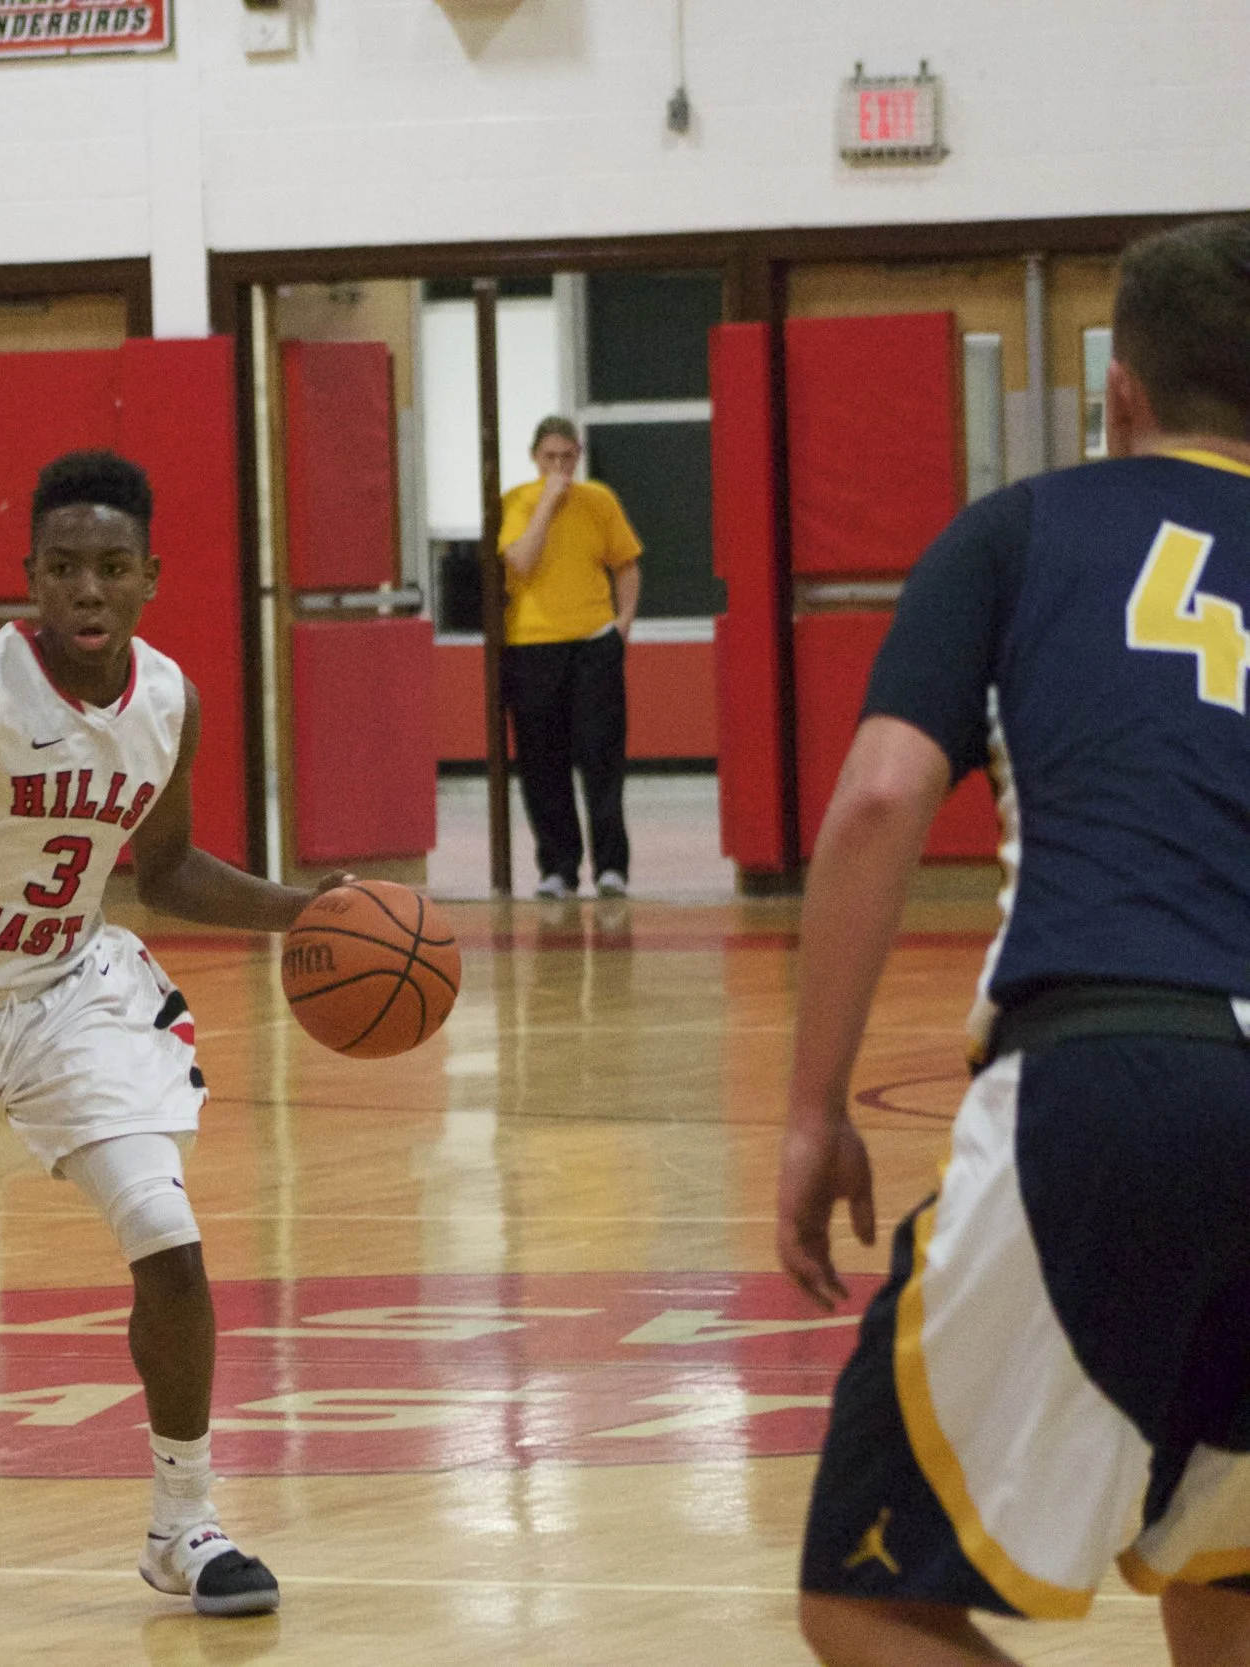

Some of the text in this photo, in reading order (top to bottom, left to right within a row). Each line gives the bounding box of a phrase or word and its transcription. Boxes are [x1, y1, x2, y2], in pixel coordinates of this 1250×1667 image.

[858, 90, 918, 141] EXIT
[1125, 519, 1250, 716] 4
[10, 768, 155, 830] HILLS
[23, 835, 93, 909] 3
